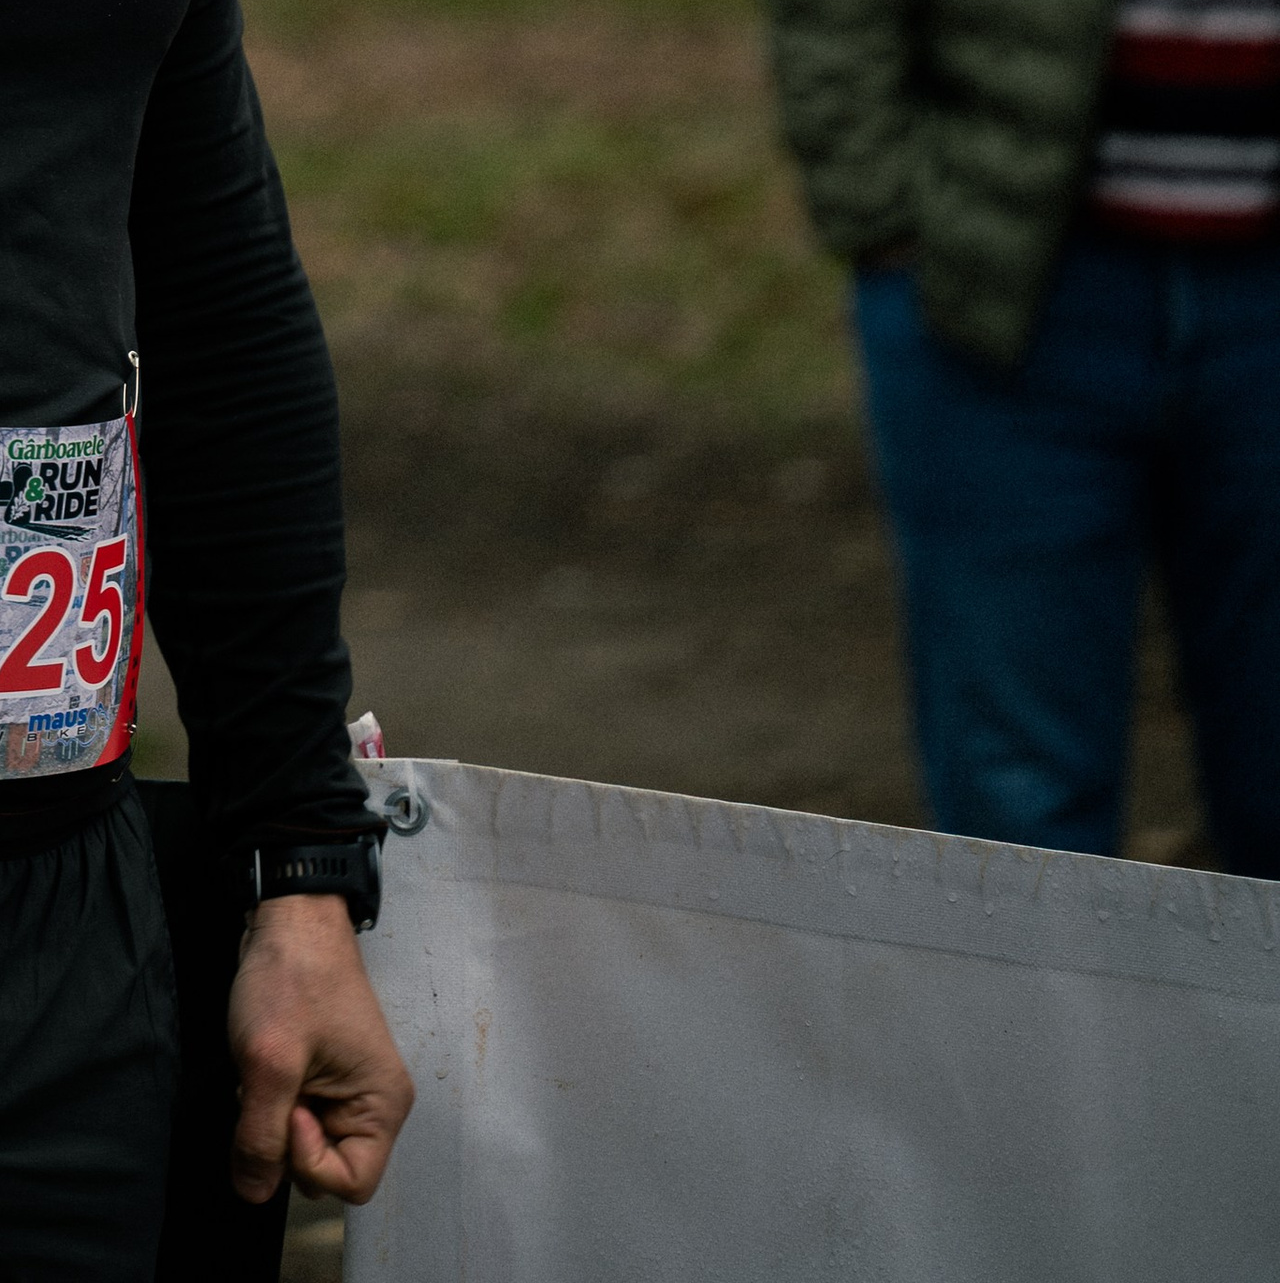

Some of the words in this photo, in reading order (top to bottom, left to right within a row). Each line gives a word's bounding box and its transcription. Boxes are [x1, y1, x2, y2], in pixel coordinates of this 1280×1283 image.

[8, 435, 105, 460] Gârboavele
[38, 458, 104, 491] RUN
[24, 477, 45, 502] &
[34, 489, 100, 522] RIDE
[28, 707, 88, 732] maus
[27, 725, 87, 742] BIKE
